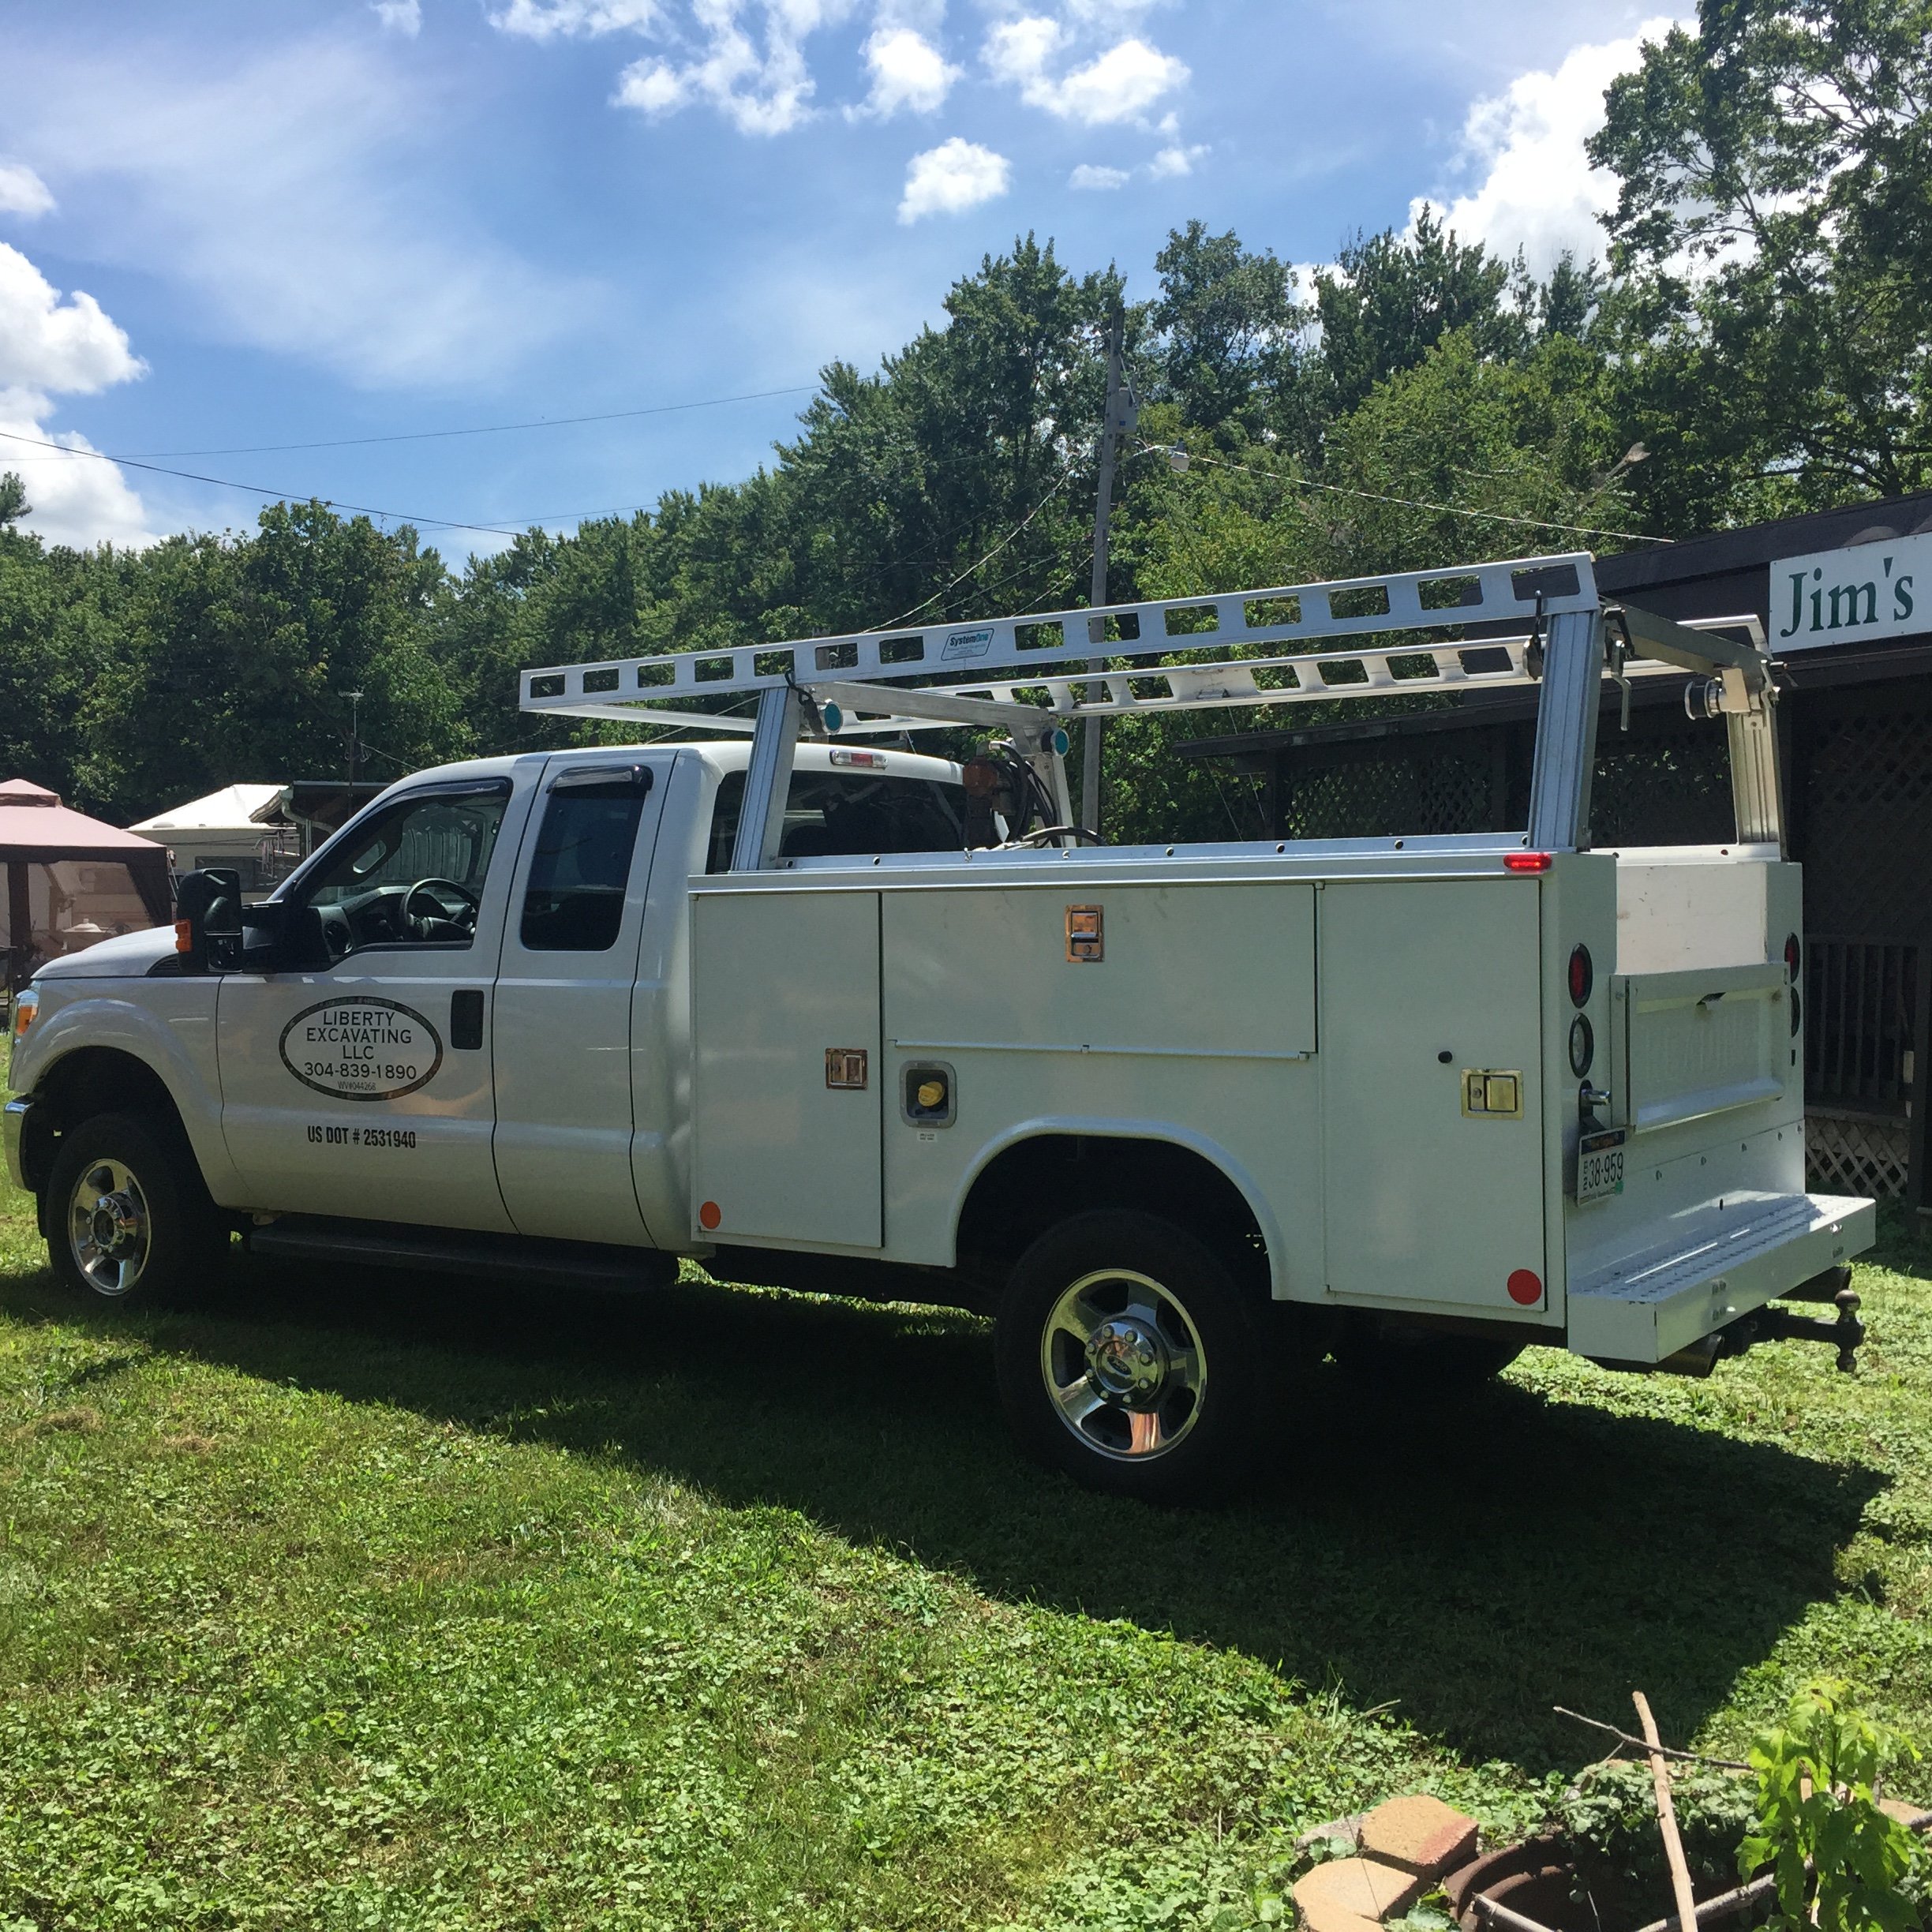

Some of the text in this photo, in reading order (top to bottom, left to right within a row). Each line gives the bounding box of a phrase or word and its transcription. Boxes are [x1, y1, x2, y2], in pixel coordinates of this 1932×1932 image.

[1780, 556, 1914, 638] Jim's
[323, 1011, 395, 1027] LIBERTY
[306, 1028, 412, 1044] EXCAVATING
[343, 1045, 375, 1060] LLC
[304, 1062, 417, 1080] 304-839-1890
[307, 1125, 417, 1149] US DOT # 2531940
